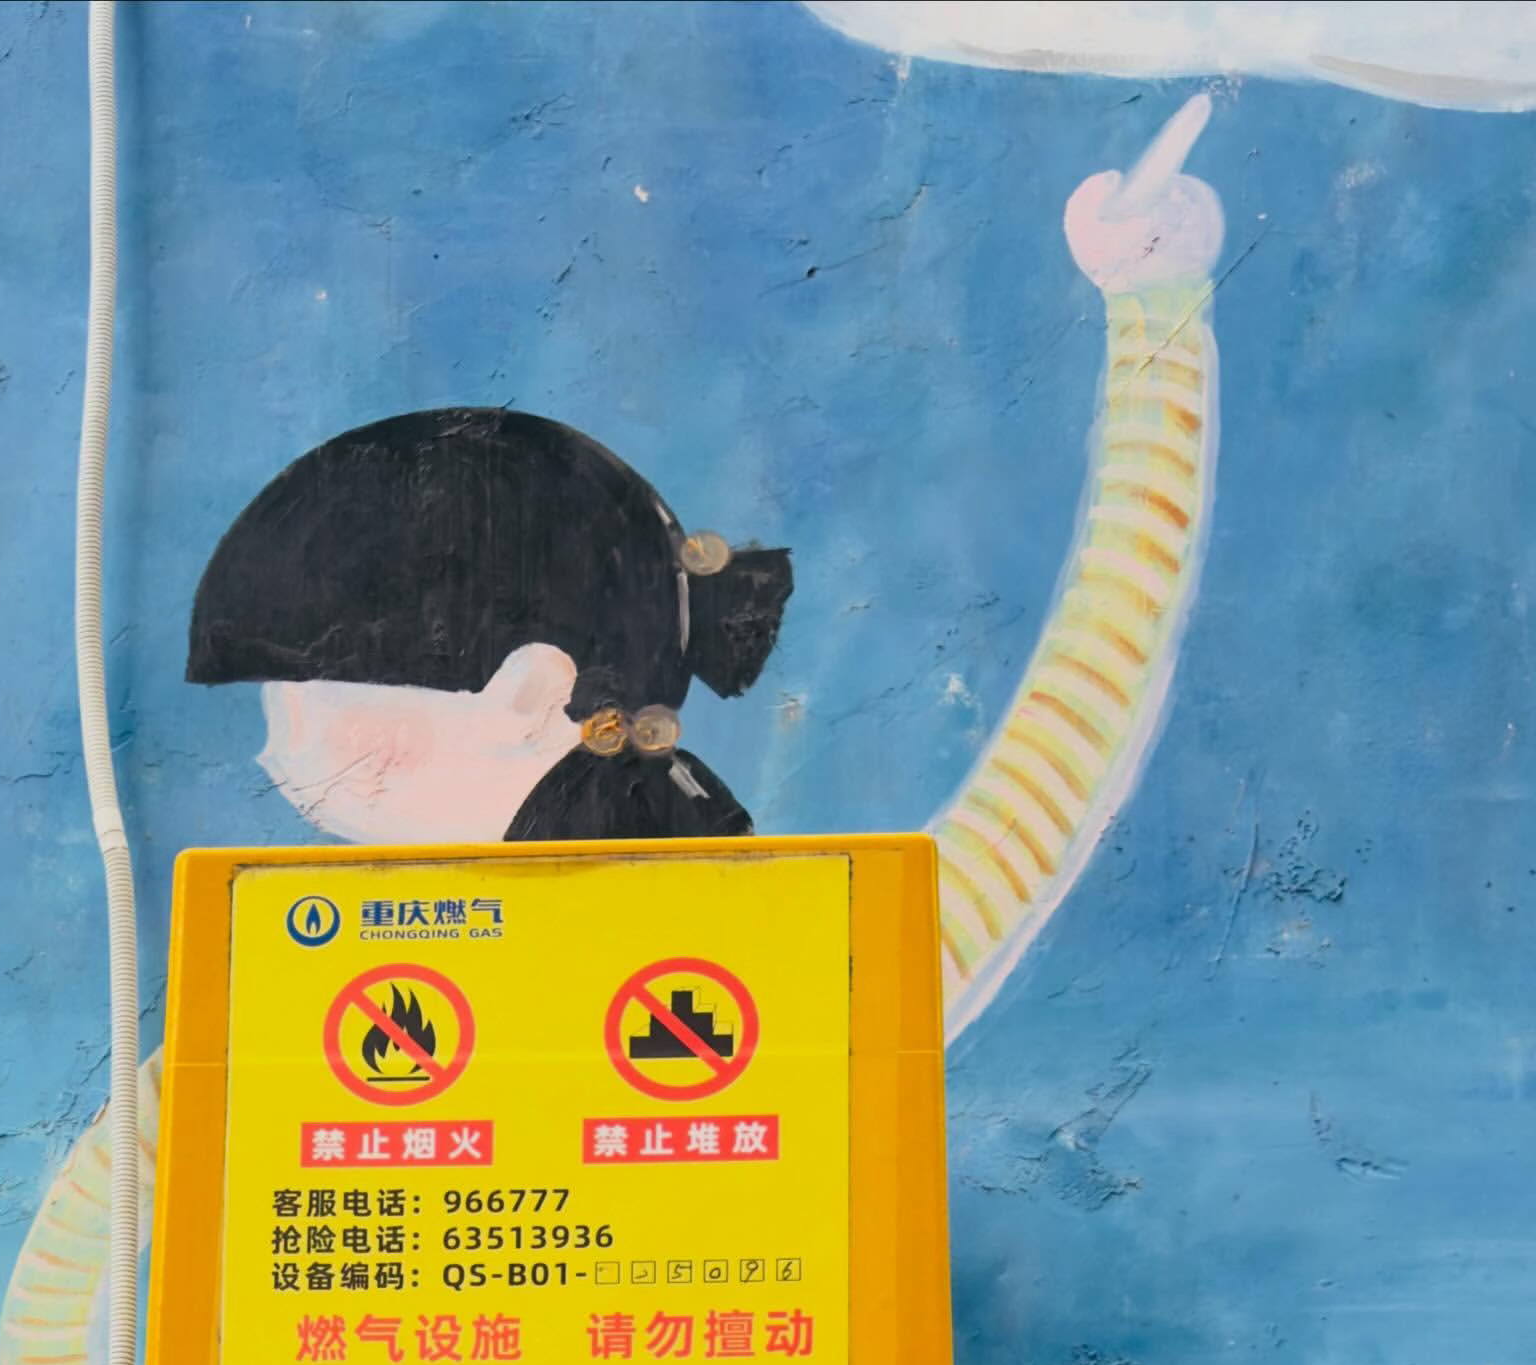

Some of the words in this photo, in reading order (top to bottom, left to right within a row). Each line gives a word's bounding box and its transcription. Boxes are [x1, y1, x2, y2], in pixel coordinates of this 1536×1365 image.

[361, 898, 503, 926] 重庆燃气
[360, 928, 460, 941] CHONGQING
[469, 927, 503, 938] GAS
[312, 1128, 482, 1160] 禁止烟火
[594, 1121, 768, 1157] 禁止堆放
[443, 1188, 570, 1214] 966777
[443, 1224, 614, 1250] 63513936
[296, 1313, 522, 1363] 燃气设施
[586, 1309, 814, 1359] 请勿擅动
